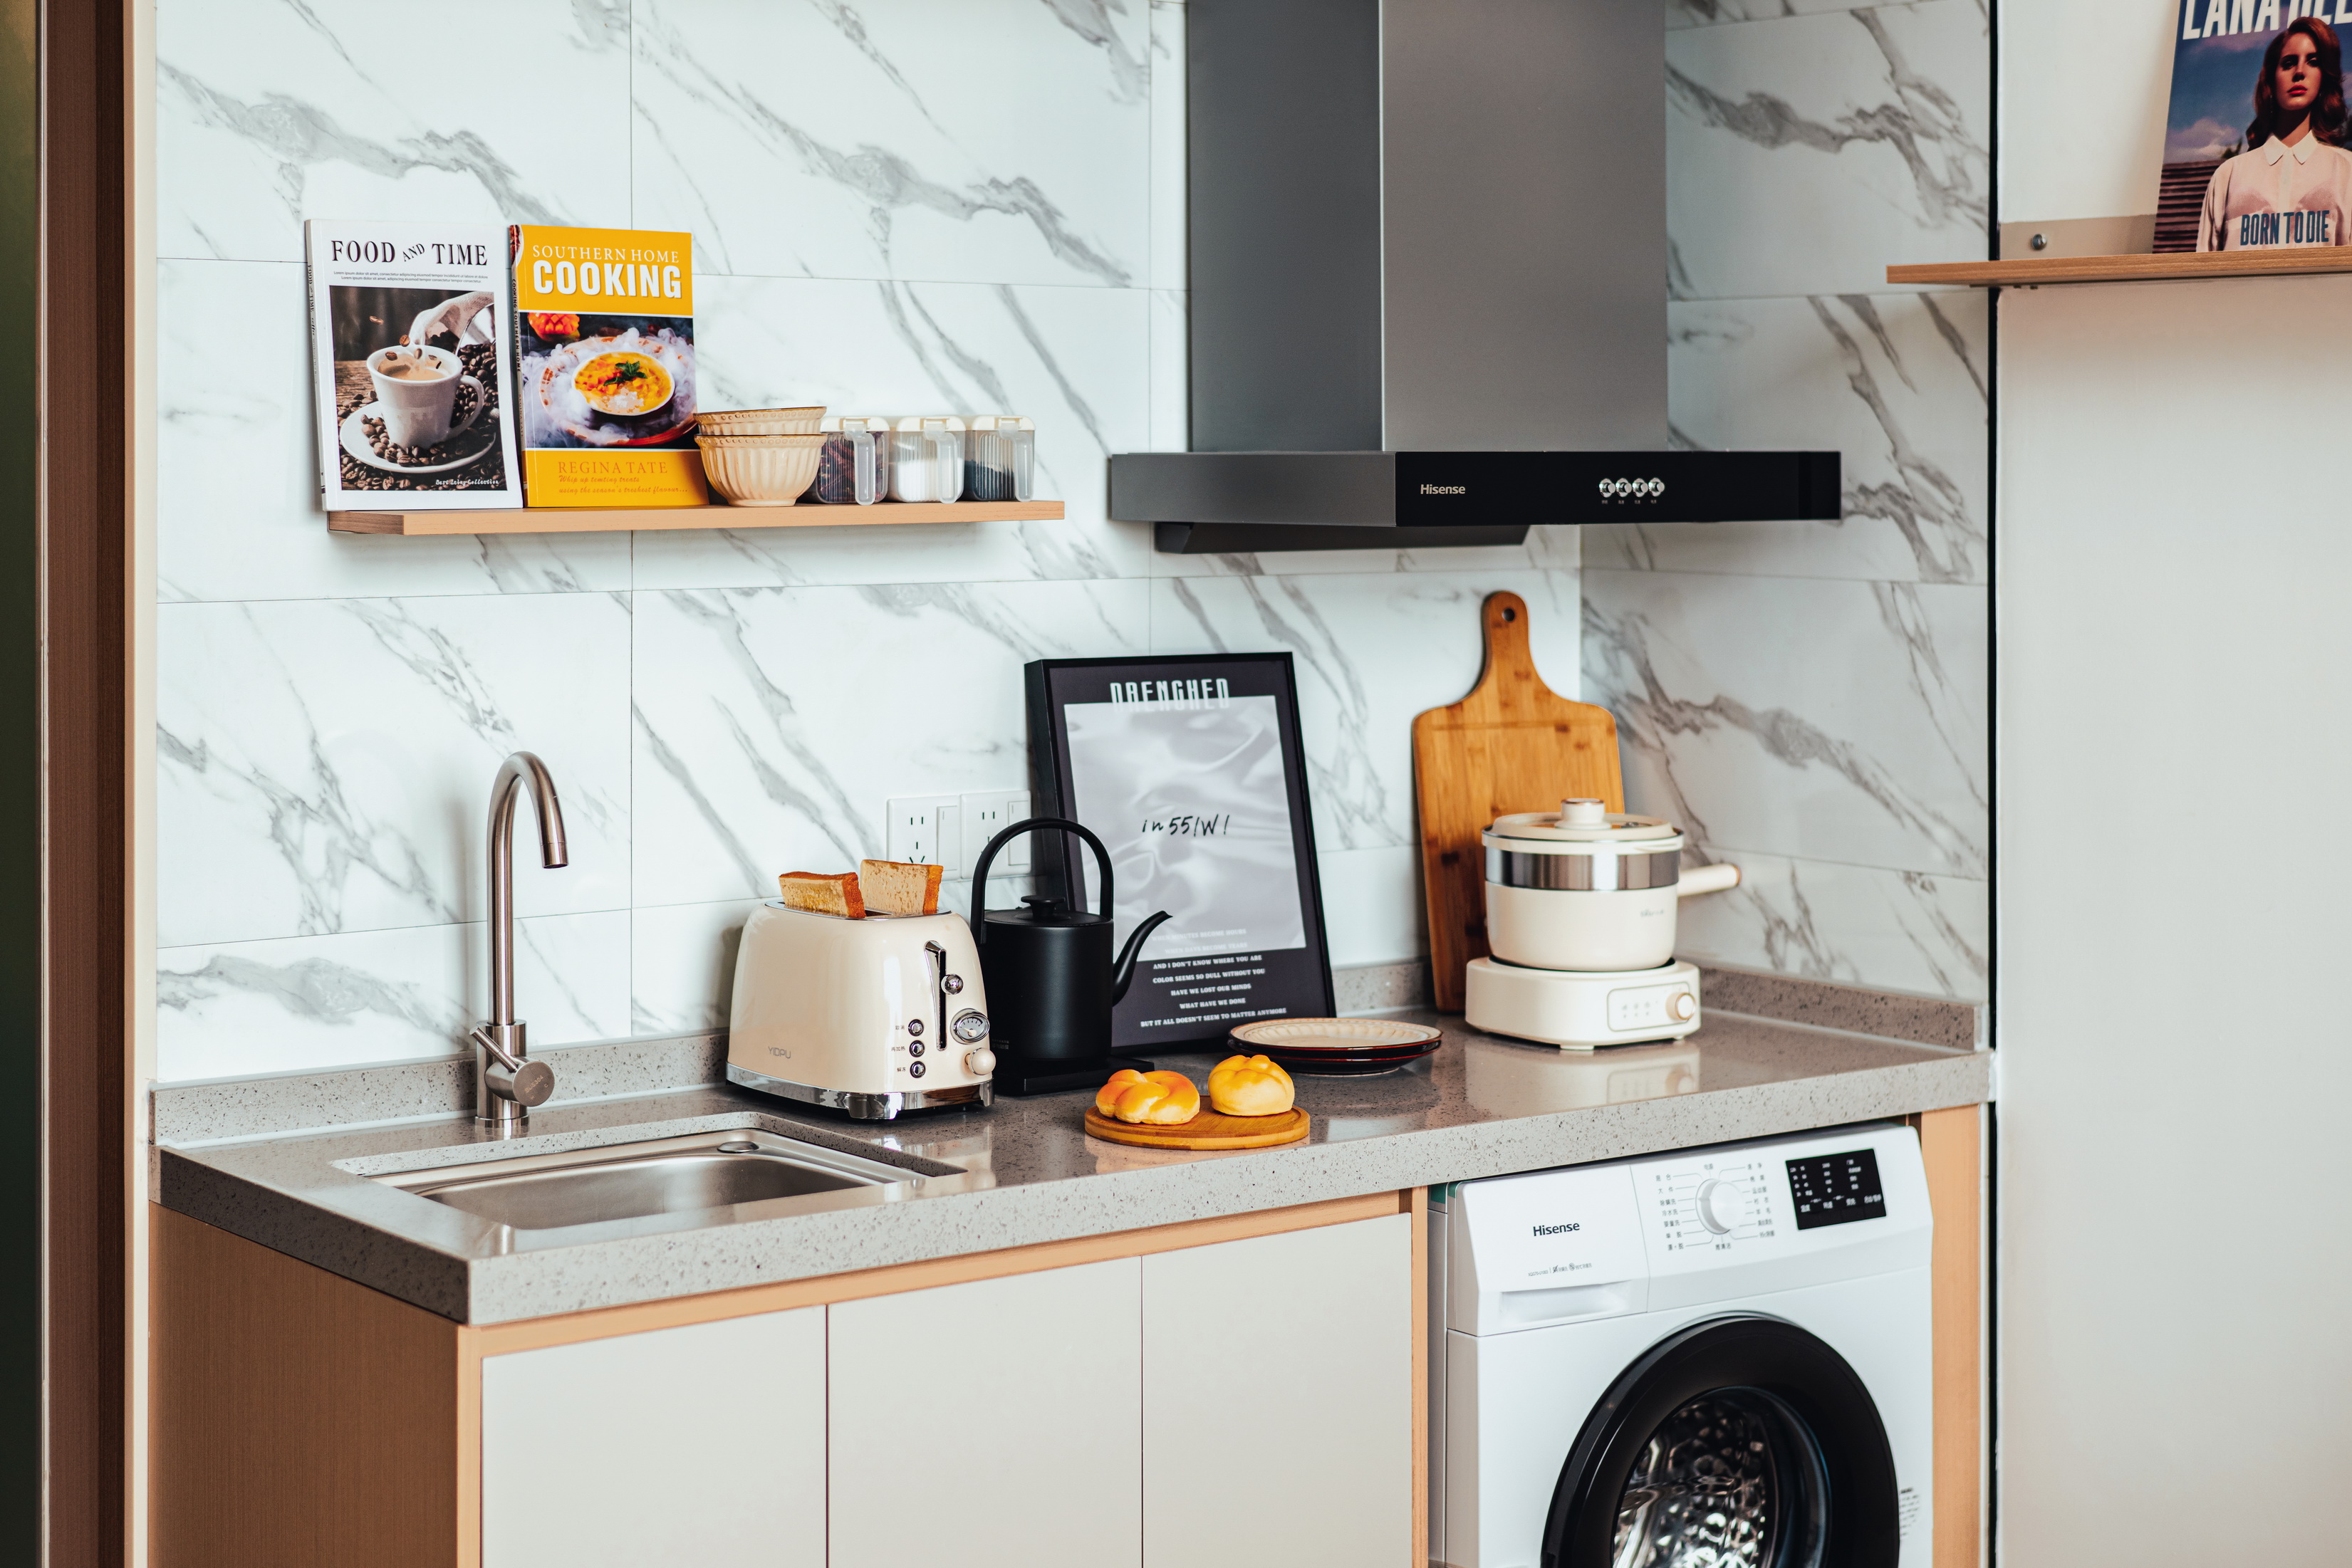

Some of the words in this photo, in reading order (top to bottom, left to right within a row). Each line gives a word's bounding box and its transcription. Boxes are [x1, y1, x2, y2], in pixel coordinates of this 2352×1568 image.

[2240, 212, 2280, 246] BORN
[2283, 211, 2304, 244] TO
[2306, 210, 2330, 243] DIE
[331, 240, 395, 263] FOOD
[402, 243, 425, 262] AND
[432, 243, 488, 266] TIME
[533, 245, 626, 261] SOUTHERN
[631, 249, 679, 263] HOME
[534, 259, 682, 298] COOKING
[558, 461, 621, 474] REGINA
[626, 462, 667, 474] TATE
[1420, 484, 1466, 495] Hisense
[1257, 1008, 1286, 1016] ANYMORE
[1533, 1223, 1580, 1236] Hisense
